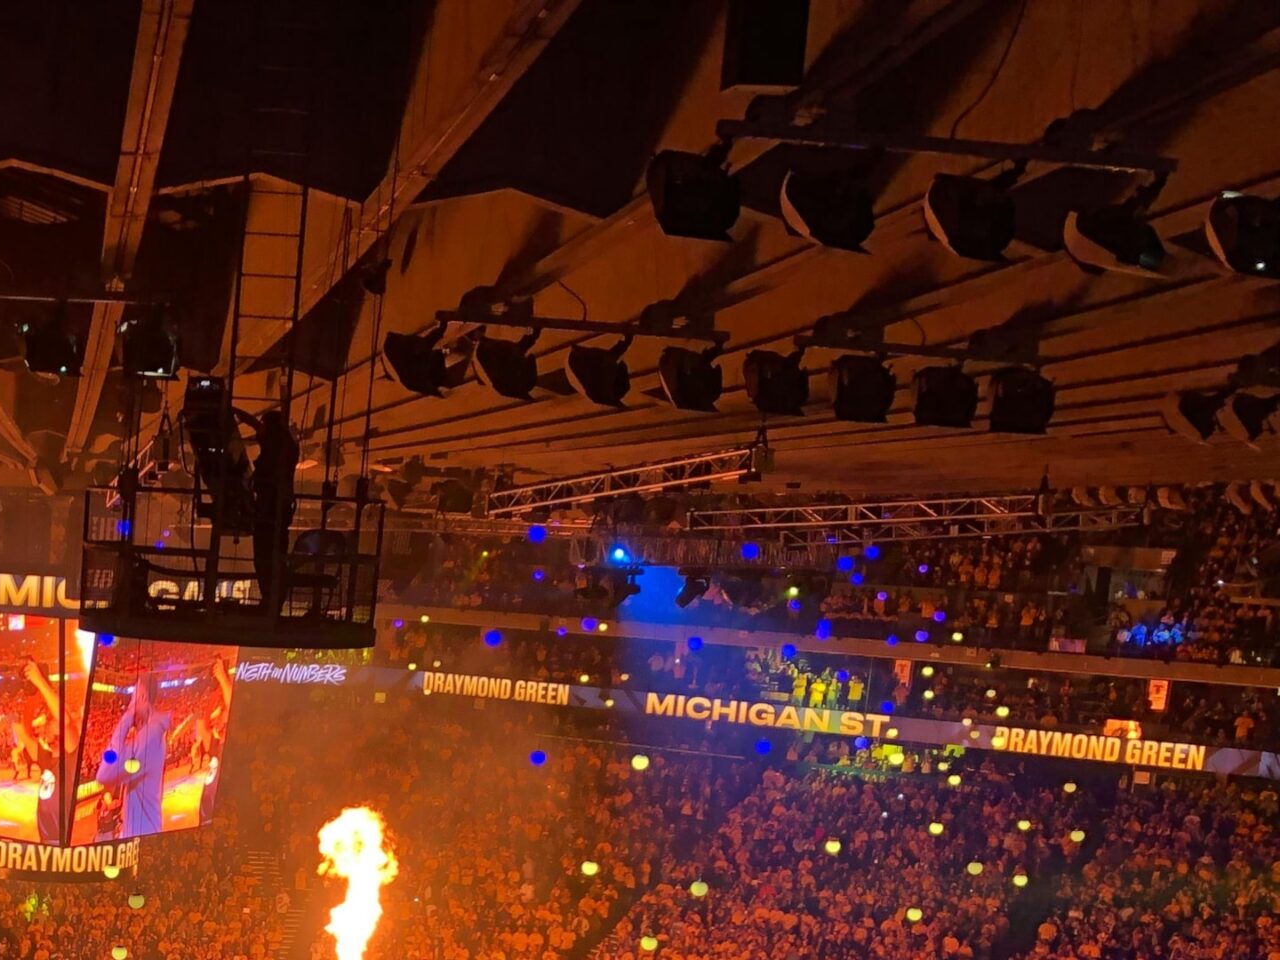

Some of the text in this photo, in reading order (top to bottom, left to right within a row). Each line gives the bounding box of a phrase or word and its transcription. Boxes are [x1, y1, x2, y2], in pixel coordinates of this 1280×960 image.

[423, 671, 569, 706] DRAYMOND GREEN
[645, 692, 831, 731] MICHIGAN
[995, 726, 1206, 771] DRAYMOND GREEN
